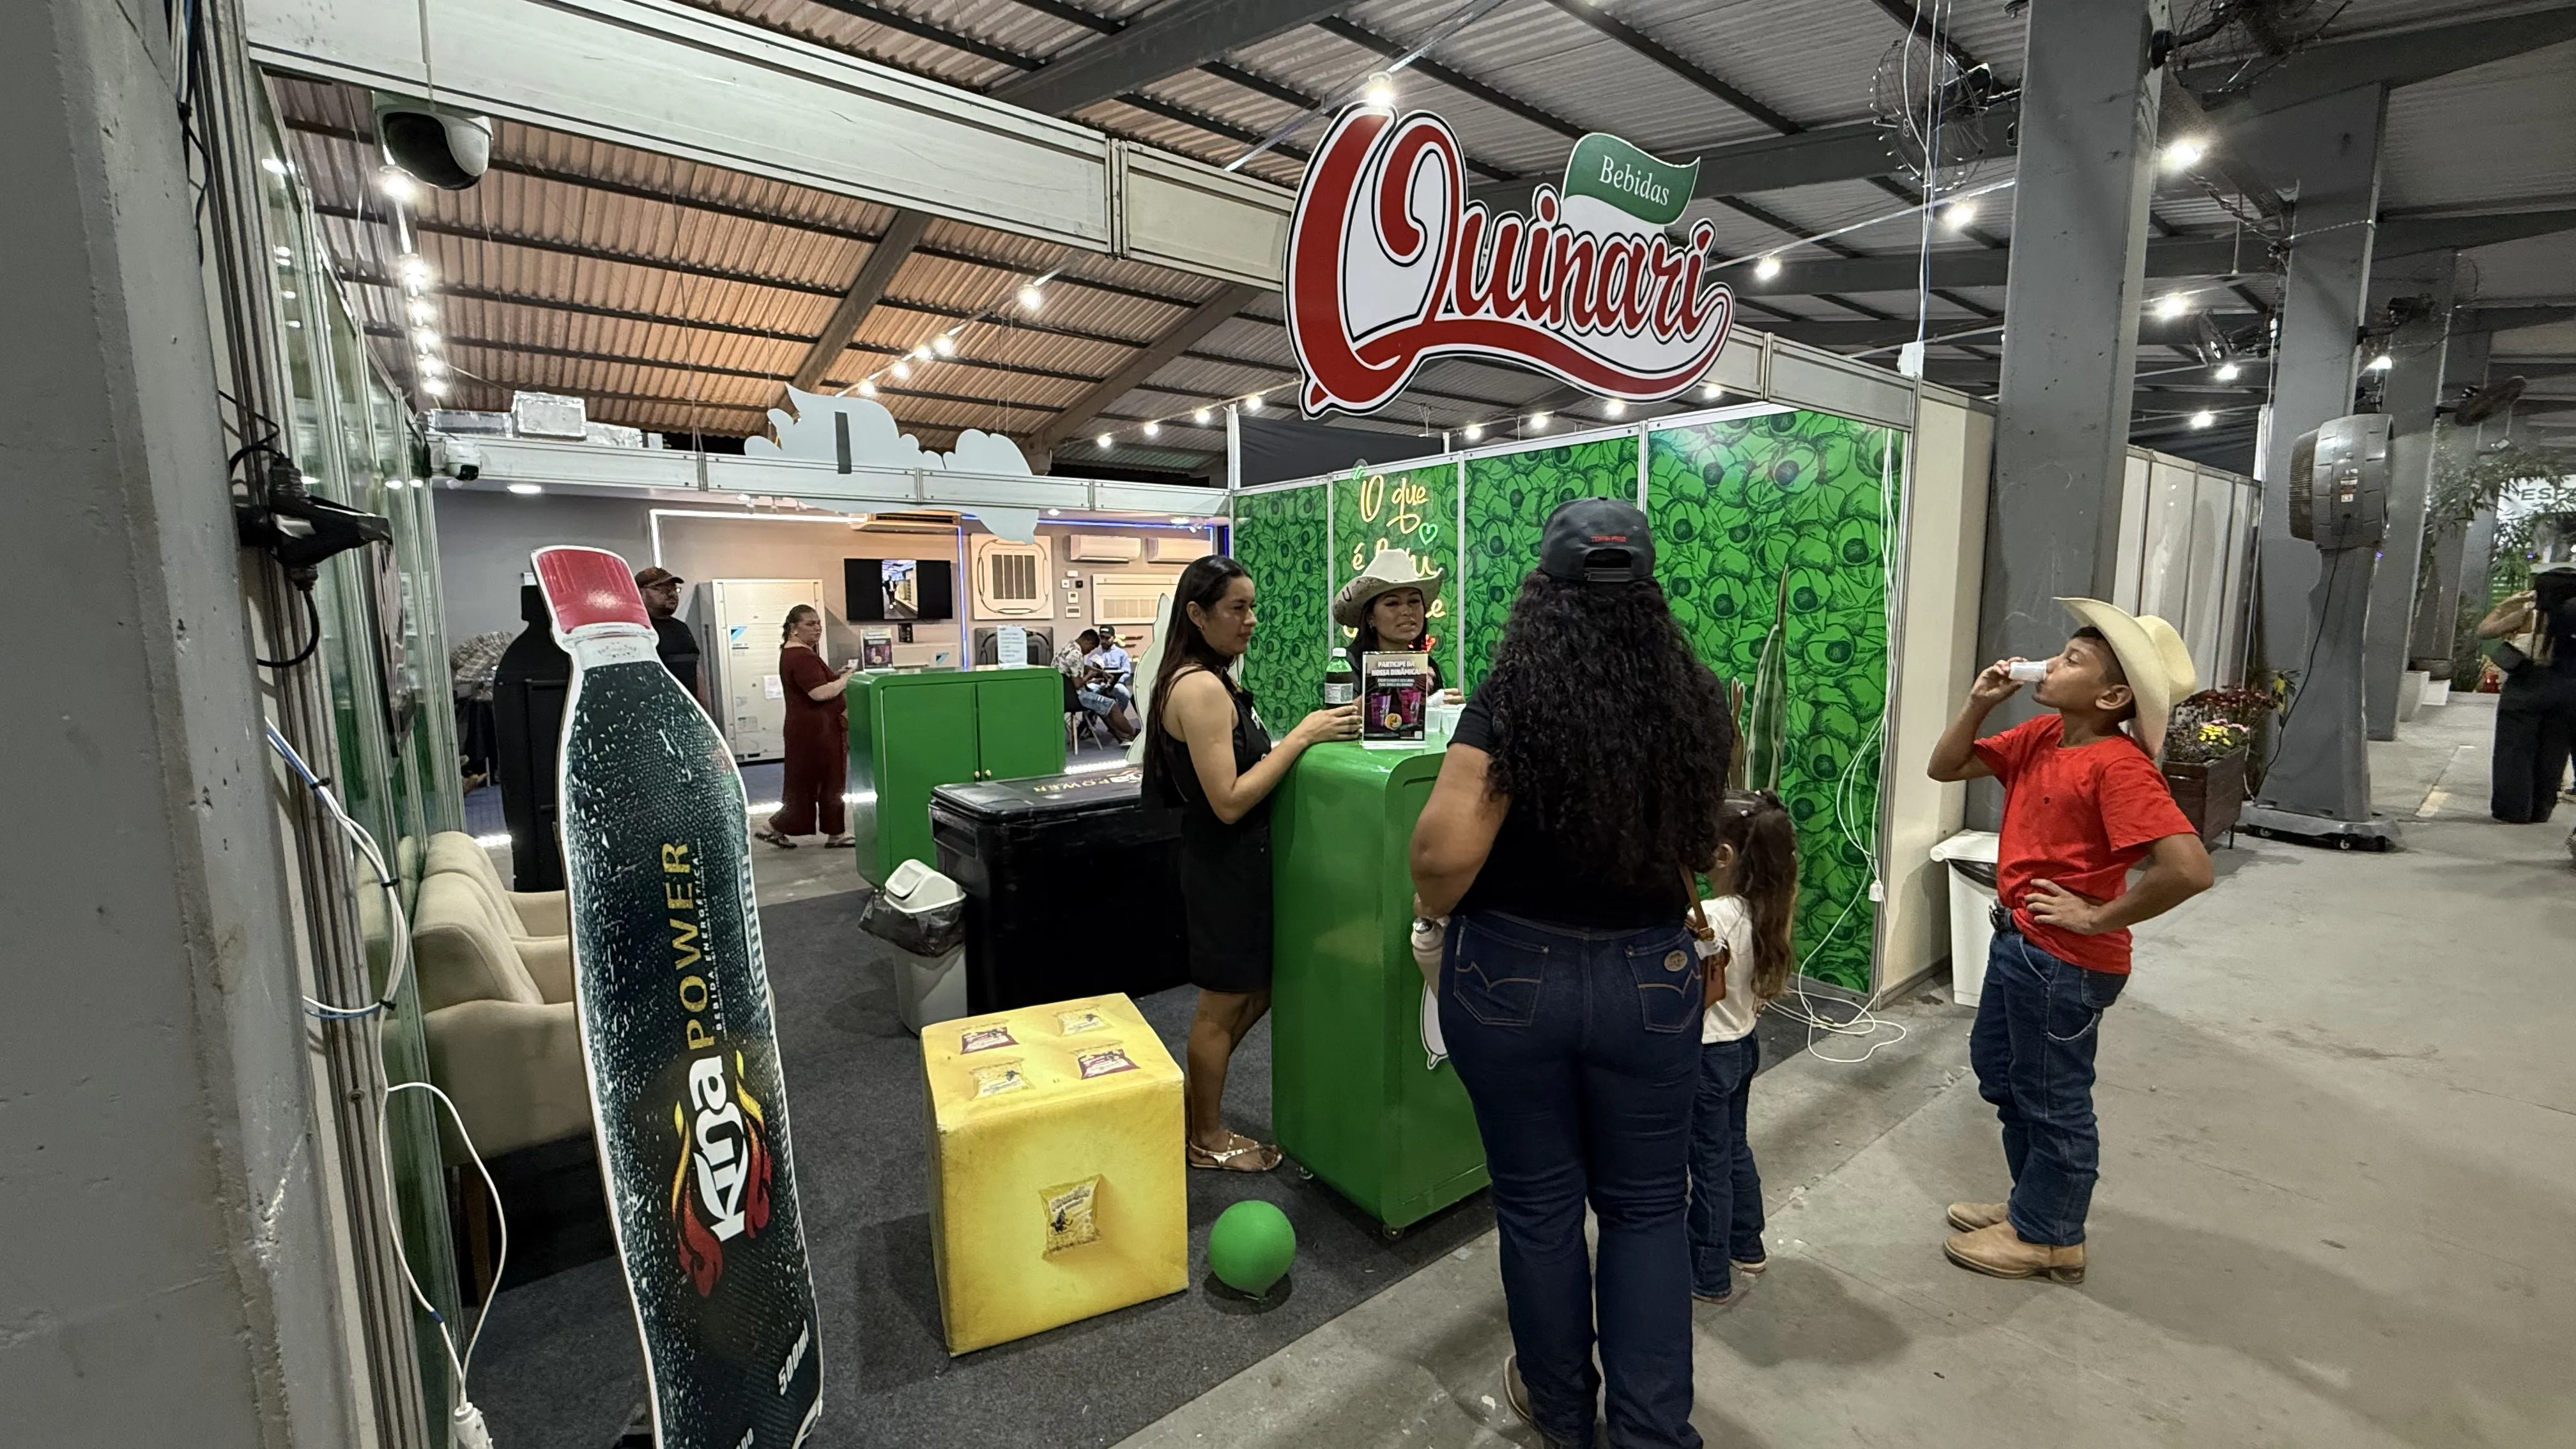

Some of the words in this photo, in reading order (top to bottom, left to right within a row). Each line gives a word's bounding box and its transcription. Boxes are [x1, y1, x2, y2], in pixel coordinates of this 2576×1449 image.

[1598, 155, 1669, 206] Bebidas
[1289, 110, 1733, 412] Quinari
[1386, 477, 1429, 534] que
[662, 843, 715, 1050] POWER
[708, 970, 723, 1031] BEBIDA
[778, 1318, 809, 1396] 500ml
